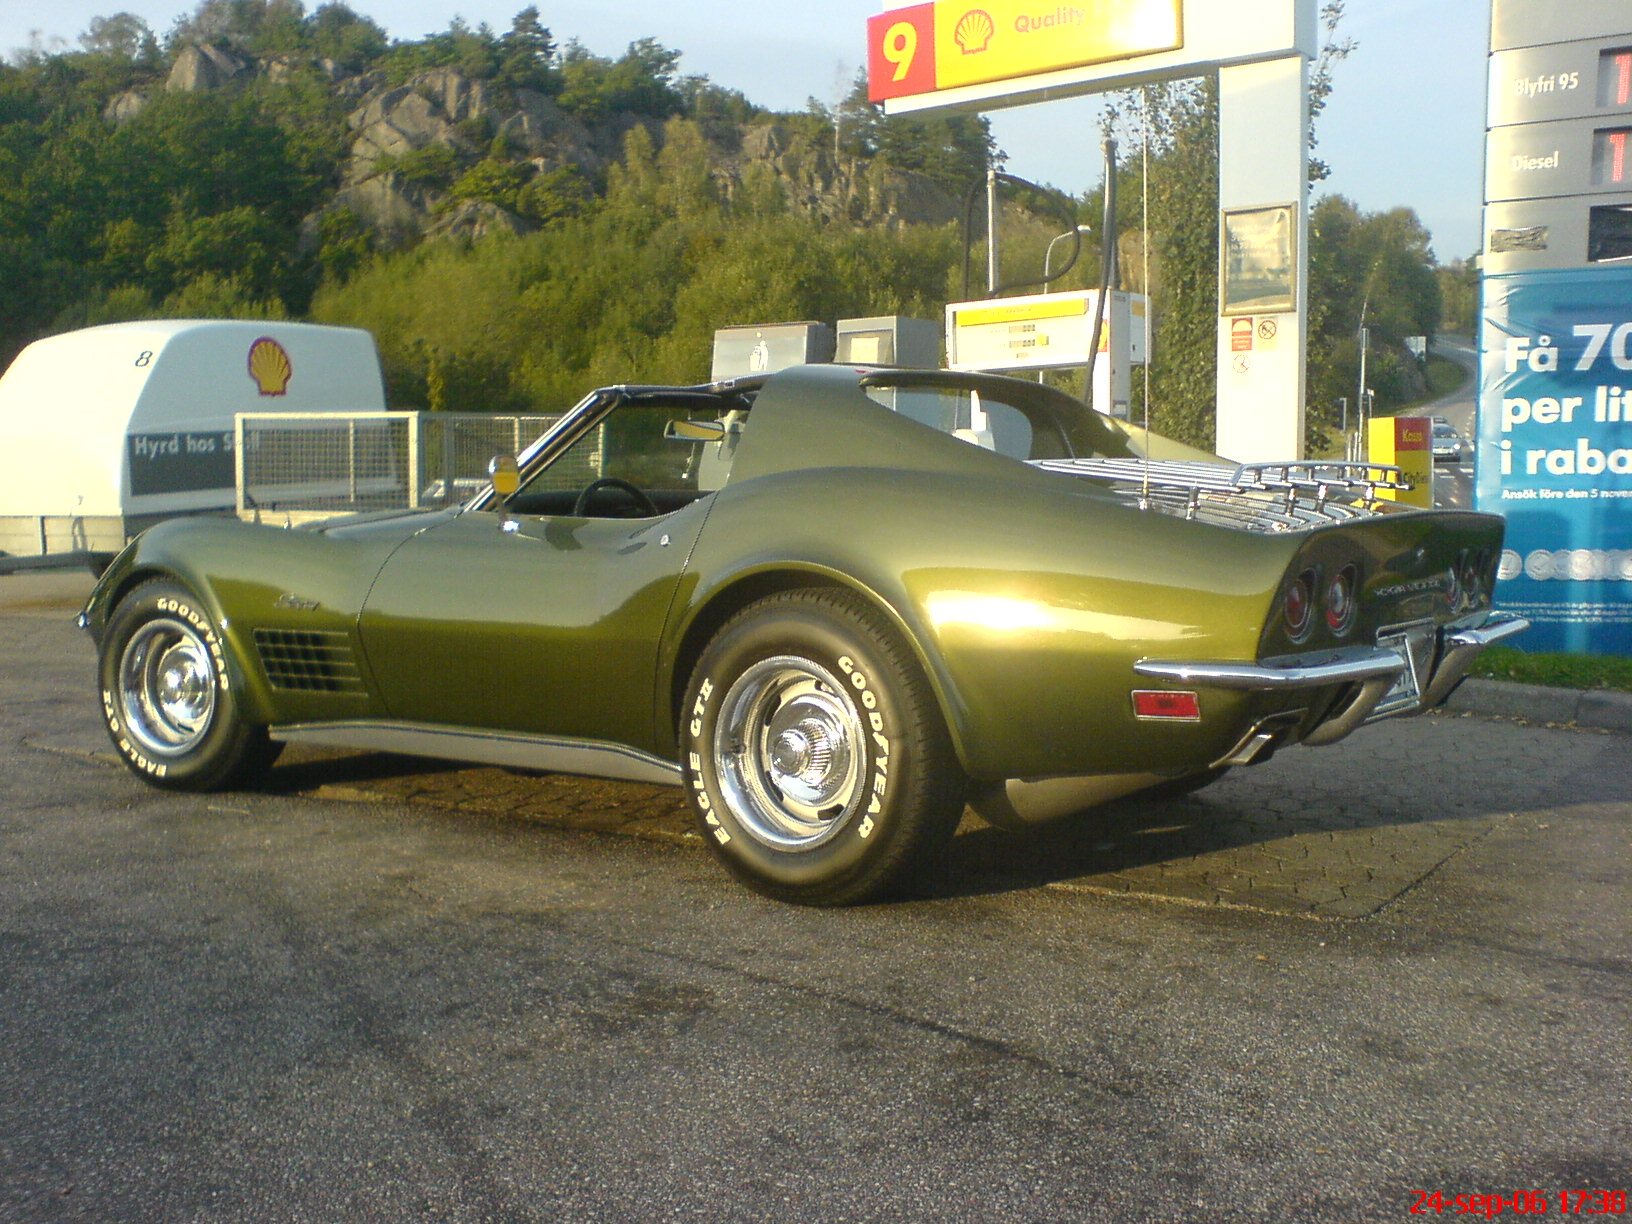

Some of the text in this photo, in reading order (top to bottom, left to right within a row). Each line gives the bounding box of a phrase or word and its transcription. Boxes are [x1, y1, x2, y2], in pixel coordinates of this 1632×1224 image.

[1014, 6, 1085, 33] Quality
[882, 21, 918, 82] 9
[1513, 75, 1554, 99] Blyfri
[1559, 72, 1578, 90] 95
[1511, 151, 1559, 172] Diesel
[135, 350, 153, 367] 8
[1504, 335, 1559, 373] Få
[1501, 396, 1582, 432] per
[134, 433, 179, 458] Hyrd
[187, 433, 217, 453] hos
[1501, 439, 1512, 475] i
[1502, 488, 1537, 500] Ansök
[1539, 488, 1563, 499] före
[1565, 488, 1588, 499] den
[1590, 488, 1598, 498] 5
[157, 596, 229, 690] GOODYEAR
[838, 656, 890, 838] GOODYEAR
[689, 751, 732, 845] EAGLE
